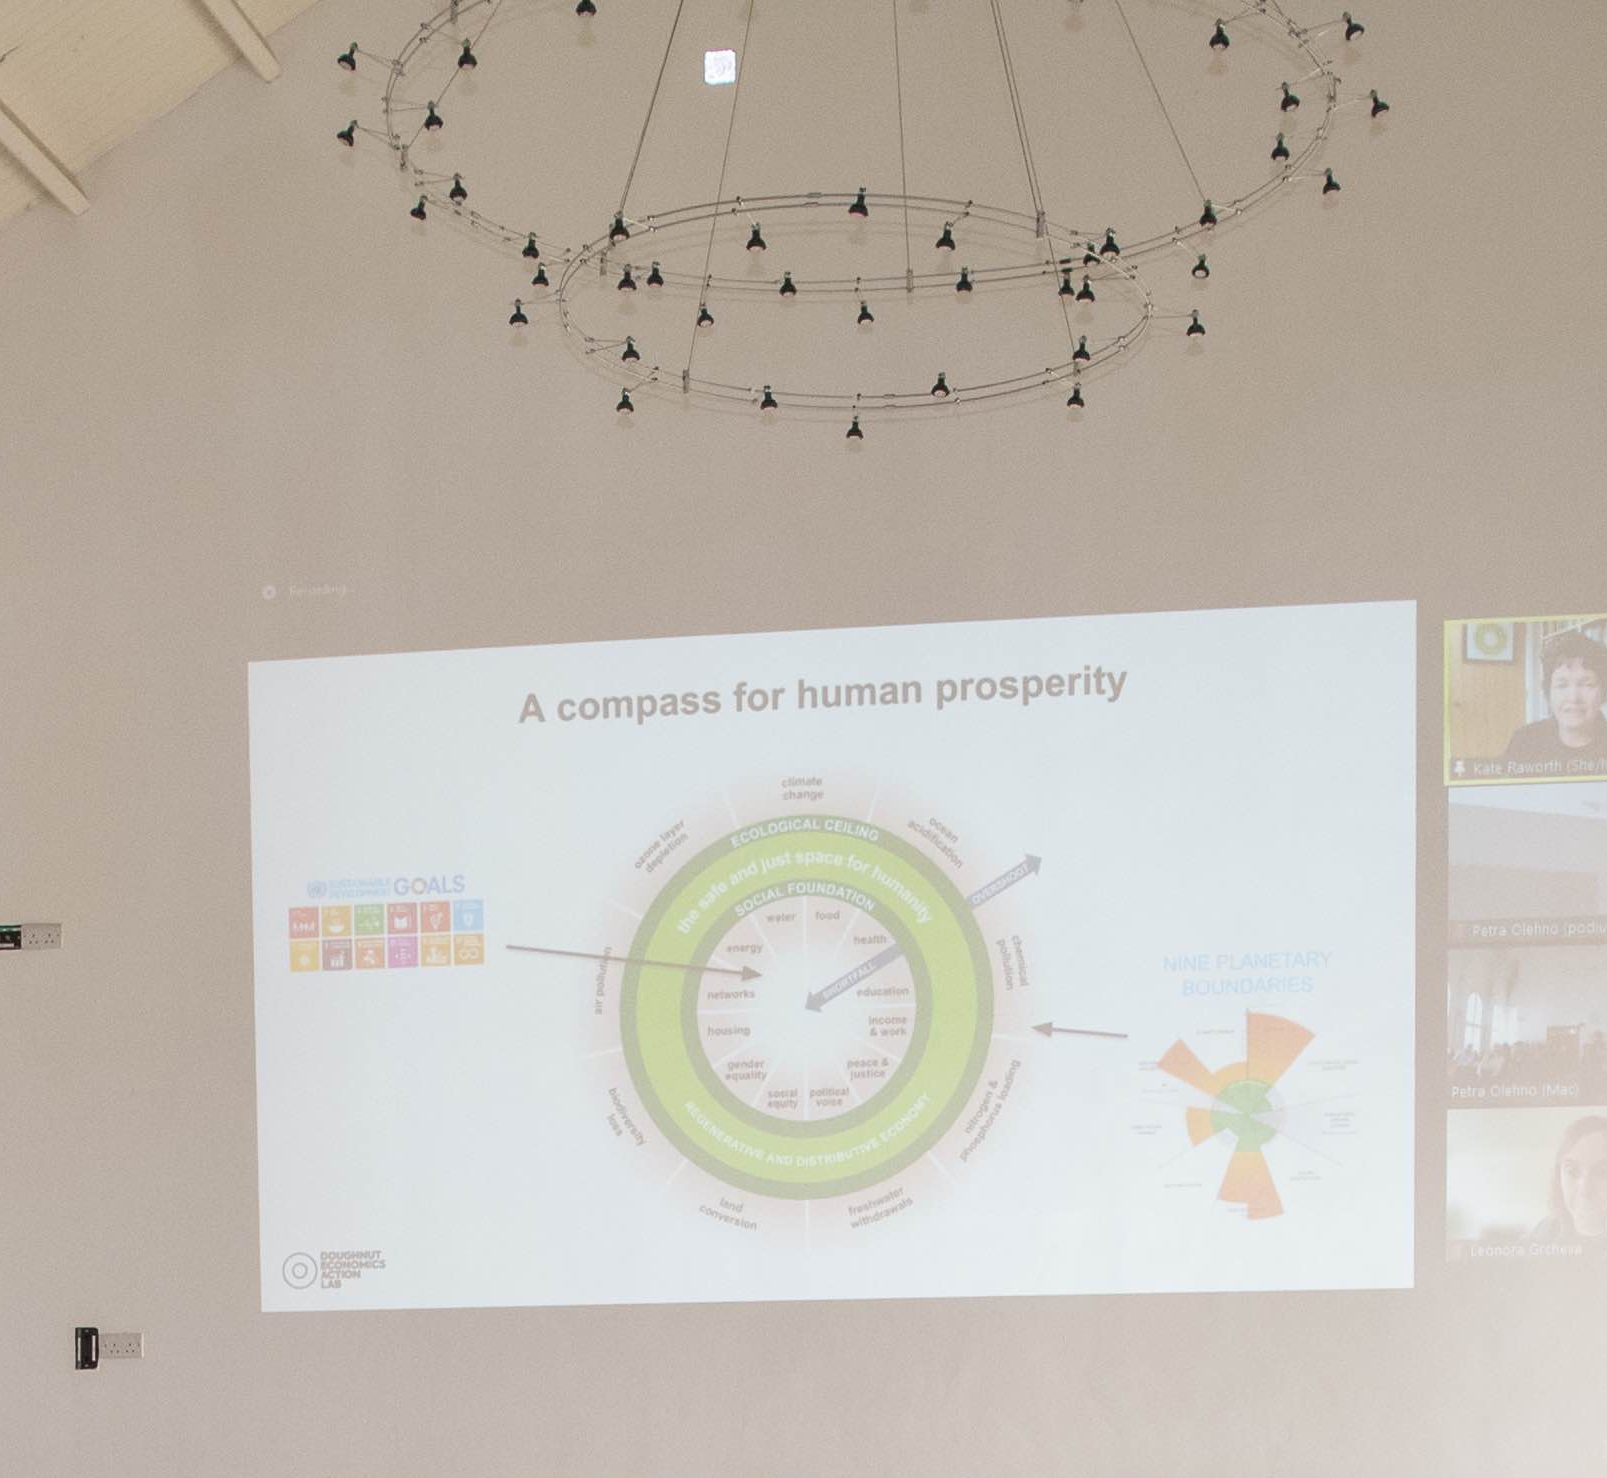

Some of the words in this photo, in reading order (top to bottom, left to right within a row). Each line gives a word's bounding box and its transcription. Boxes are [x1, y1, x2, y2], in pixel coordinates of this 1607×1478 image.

[519, 693, 544, 724] A
[556, 687, 722, 725] compass
[734, 681, 785, 713] for
[796, 677, 922, 711] human
[936, 665, 1128, 707] prosperity
[1473, 762, 1506, 776] Kate
[780, 776, 823, 788] climate
[782, 788, 824, 801] change
[731, 819, 821, 848] ECOLOGICAL
[825, 816, 880, 841] CEILING
[928, 817, 959, 842] ocean
[907, 820, 964, 869] acidification
[646, 833, 689, 872] depletion
[394, 874, 465, 896] GOALS
[675, 908, 699, 935] the
[697, 881, 730, 911] safe
[728, 863, 760, 886] and
[760, 851, 792, 875] just
[794, 850, 843, 867] space
[846, 851, 871, 875] for
[871, 866, 932, 923] humanity
[735, 883, 785, 917] SOCIAL
[787, 881, 875, 911] FOUNDATION
[766, 912, 796, 923] water
[815, 910, 840, 921] food
[853, 934, 889, 945] health
[726, 943, 763, 955] energy
[995, 939, 1013, 991] pollution
[1012, 934, 1030, 986] chemical
[1162, 953, 1211, 972] NINE
[1215, 950, 1333, 971] PLANETARY
[856, 986, 910, 997] education
[1182, 975, 1314, 997] BOUNDARIES
[707, 989, 756, 1001] networks
[594, 998, 603, 1016] air
[868, 1015, 907, 1026] income
[707, 1025, 751, 1038] housing
[869, 1026, 879, 1037] &
[880, 1025, 907, 1037] work
[727, 1058, 765, 1070] gender
[847, 1059, 880, 1070] peace
[725, 1069, 767, 1083] equality
[850, 1068, 886, 1081] justice
[767, 1088, 798, 1099] social
[809, 1087, 849, 1098] political
[767, 1099, 798, 1111] equity
[816, 1098, 843, 1107] voice
[959, 1102, 1002, 1163] phosphorus
[999, 1059, 1021, 1101] loading
[606, 1113, 624, 1137] loss
[765, 1153, 794, 1166] AND
[879, 1092, 931, 1142] ECONOMY
[719, 1197, 744, 1213] land
[847, 1186, 904, 1216] freshwater
[699, 1204, 758, 1231] conversion
[320, 1250, 381, 1260] DOUGHNUT
[320, 1260, 386, 1270] ECONOMICS
[320, 1270, 361, 1279] ACTION
[320, 1280, 342, 1289] LAB
